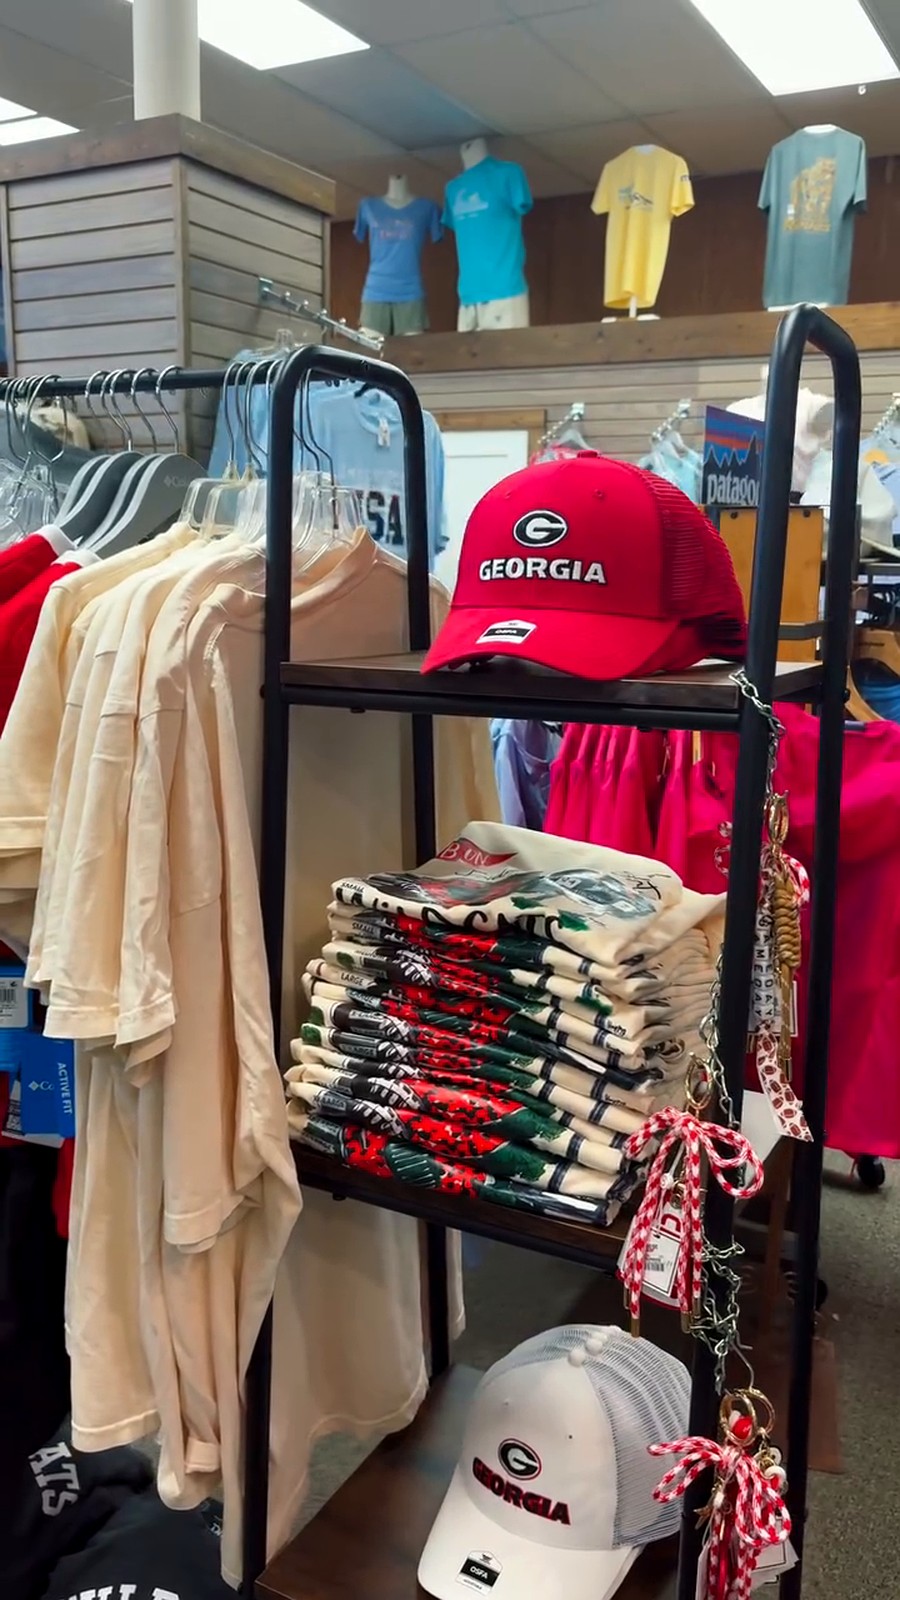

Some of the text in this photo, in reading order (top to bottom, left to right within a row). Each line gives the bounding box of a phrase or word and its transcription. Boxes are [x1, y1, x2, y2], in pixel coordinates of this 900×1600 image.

[479, 557, 607, 584] GEORGIA
[340, 882, 364, 893] SMALL
[340, 972, 363, 986] LARGE
[57, 1062, 73, 1114] ACTIVE FIT
[28, 1442, 80, 1517] ATS
[472, 1456, 571, 1525] GEORGIA
[470, 1566, 488, 1579] OSFA
